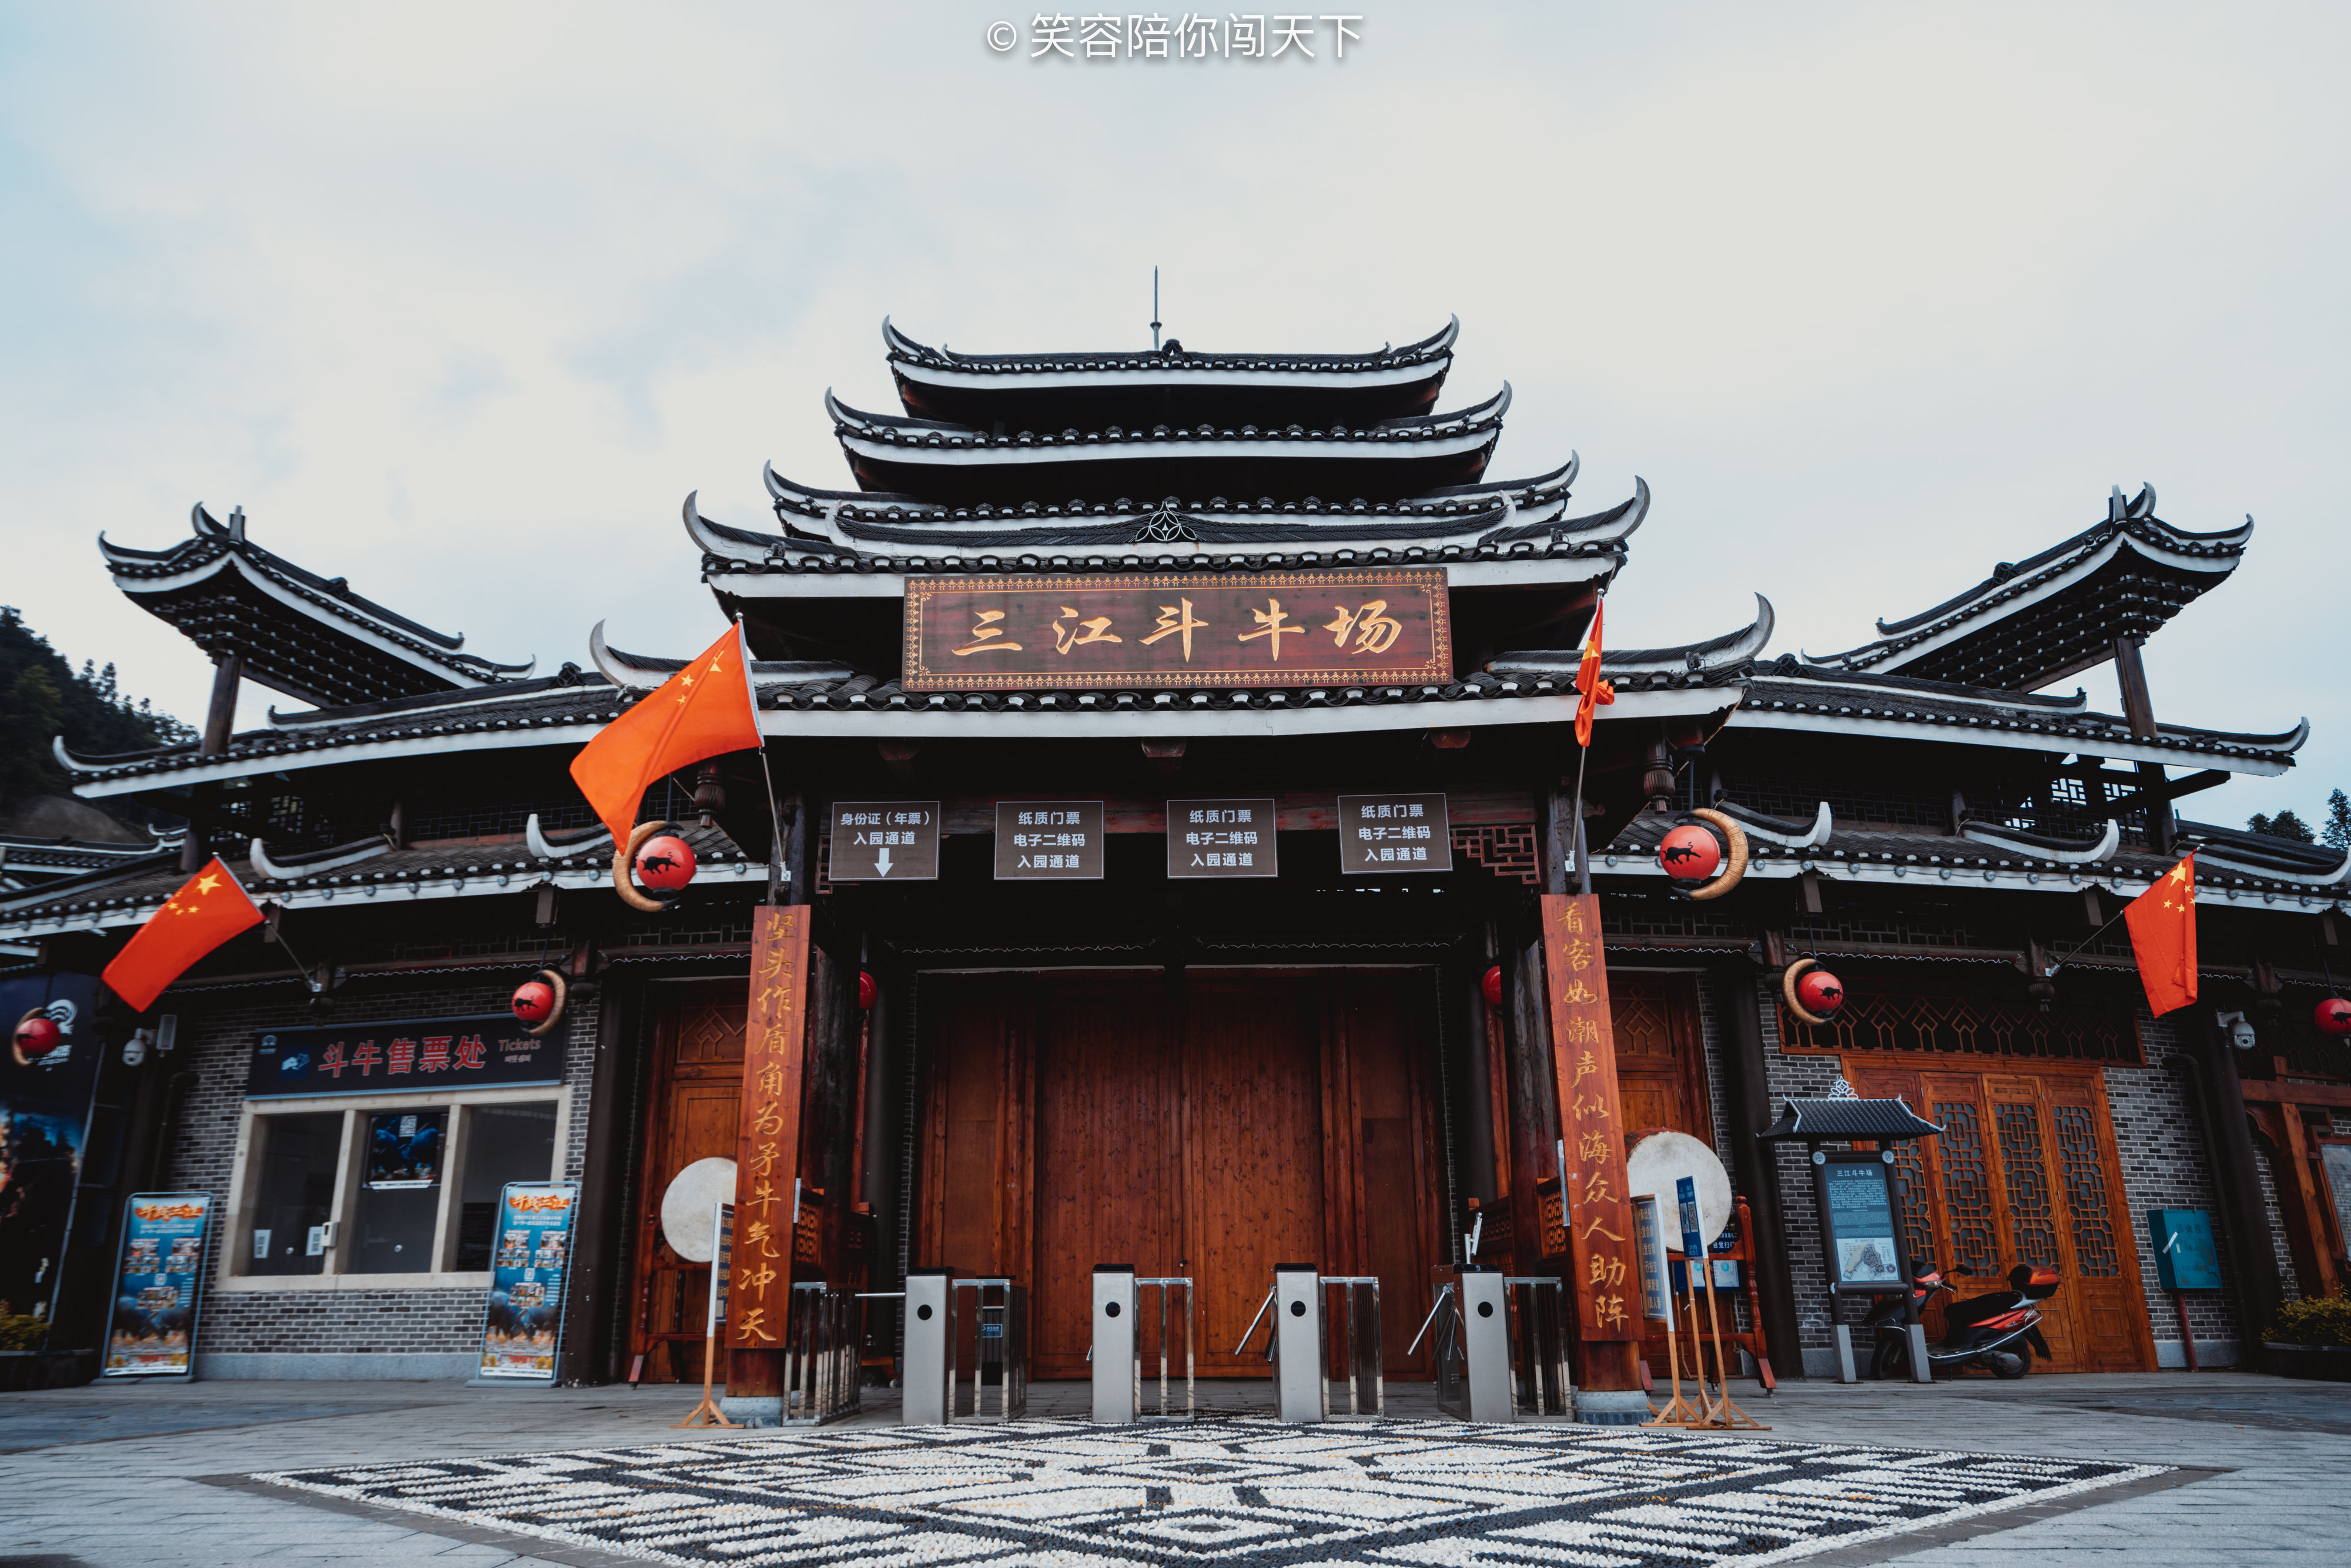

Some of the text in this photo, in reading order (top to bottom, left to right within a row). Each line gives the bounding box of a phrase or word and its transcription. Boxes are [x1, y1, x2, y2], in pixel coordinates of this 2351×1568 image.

[951, 596, 1402, 662] 三江斗牛场
[1190, 809, 1252, 823] 纸质门票
[1361, 803, 1424, 819] 纸质门票
[840, 811, 930, 826] 身份证（年票）
[1018, 812, 1080, 825] 纸质门票
[853, 831, 915, 845] 入园通道
[1014, 833, 1086, 847] 电子二维码
[1186, 832, 1258, 845] 电子二维码
[1358, 826, 1431, 840] 电子二维码
[1017, 855, 1080, 868] 入园通道
[1190, 852, 1253, 867] 入园通道
[1365, 847, 1428, 862] 入园通道
[498, 1038, 541, 1051] Tickets
[318, 1034, 487, 1078] 斗牛售票处
[1556, 900, 1629, 1332] 看客如潮声似海众人助阵
[2176, 1223, 2202, 1234] 消火栓
